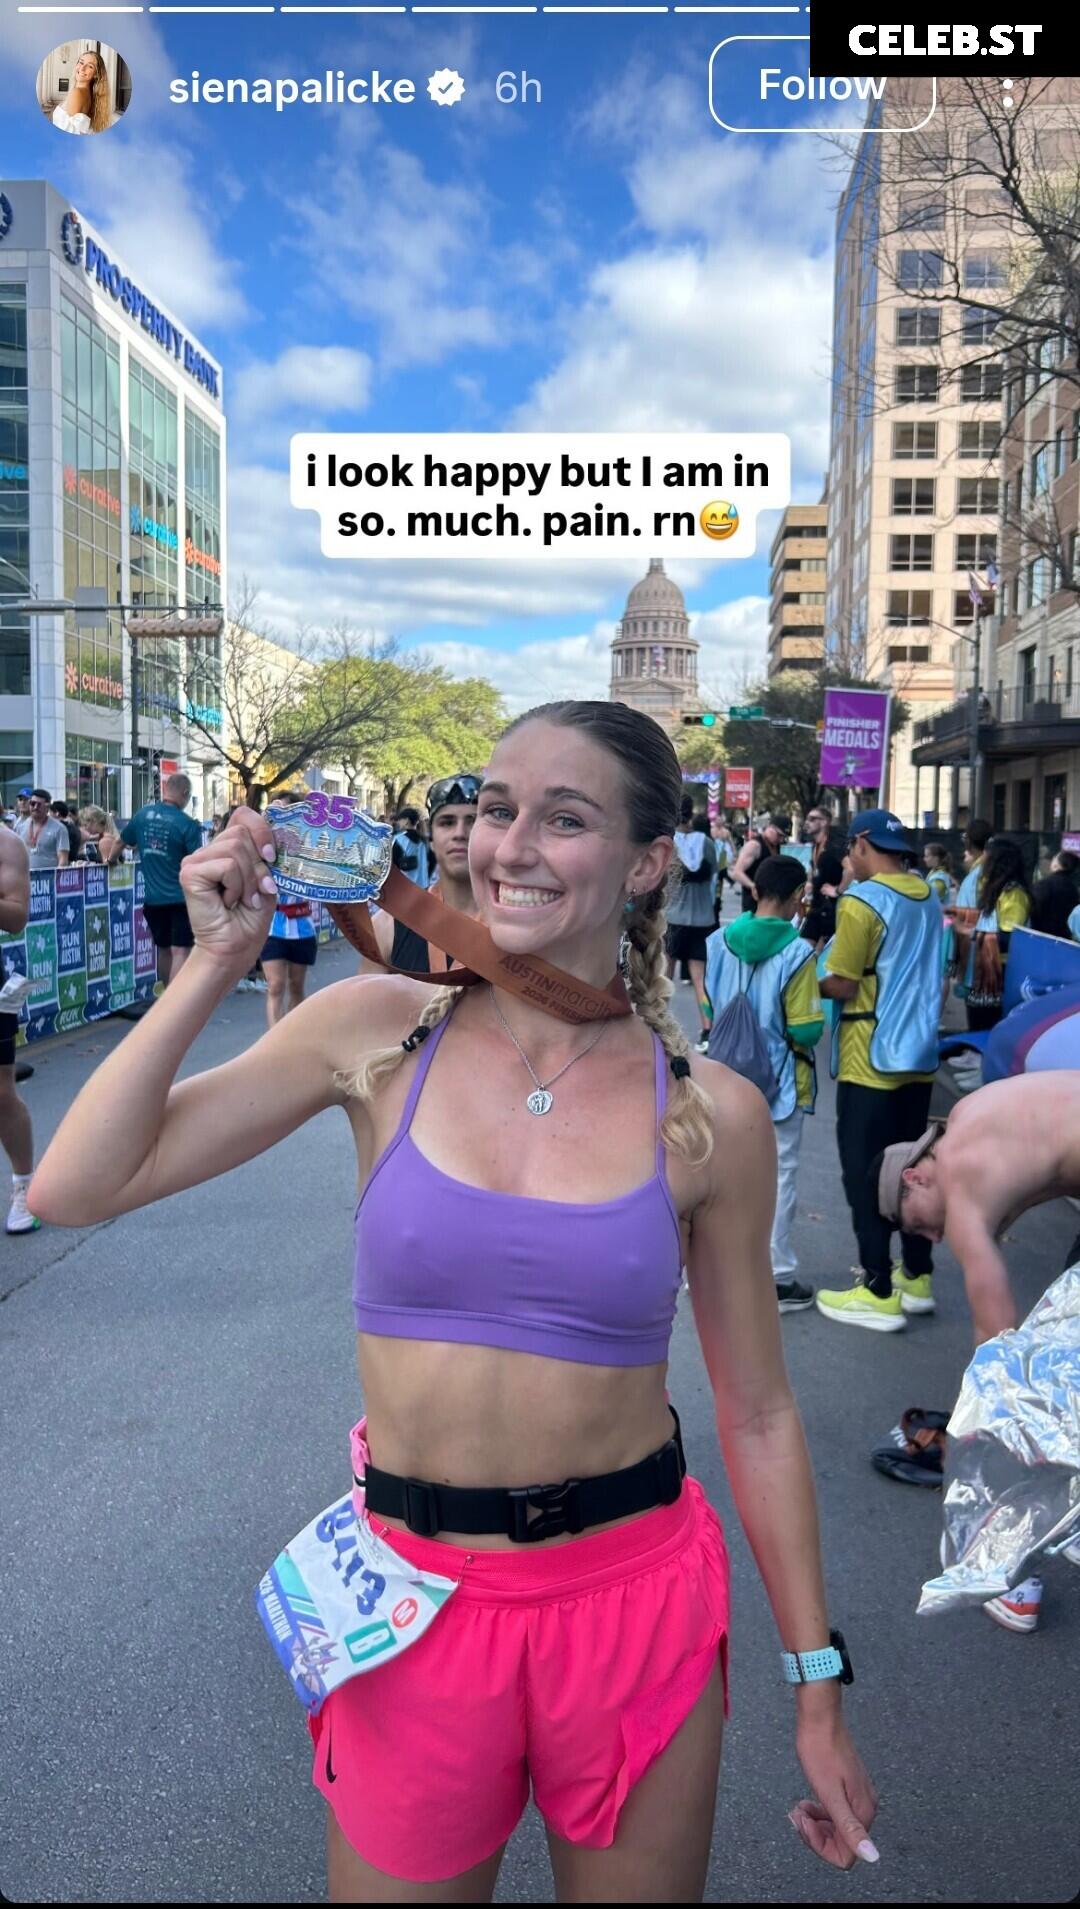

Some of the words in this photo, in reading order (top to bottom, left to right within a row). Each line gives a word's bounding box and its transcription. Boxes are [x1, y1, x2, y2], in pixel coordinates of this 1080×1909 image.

[84, 236, 184, 361] PROSPERITY
[183, 339, 220, 398] BANK
[80, 477, 121, 517] curative
[82, 672, 123, 700] curative
[826, 716, 881, 729] FINISHER
[823, 729, 881, 750] MEDALS
[302, 790, 359, 831] 35
[30, 879, 50, 895] RUN
[113, 921, 131, 938] RUN
[61, 931, 81, 949] RUN
[88, 940, 106, 957] RUN
[61, 946, 82, 966] AUSTIN
[32, 960, 53, 979] RUN
[521, 985, 550, 1005] 2026
[263, 1592, 293, 1642] MARATHON
[395, 1600, 415, 1624] M
